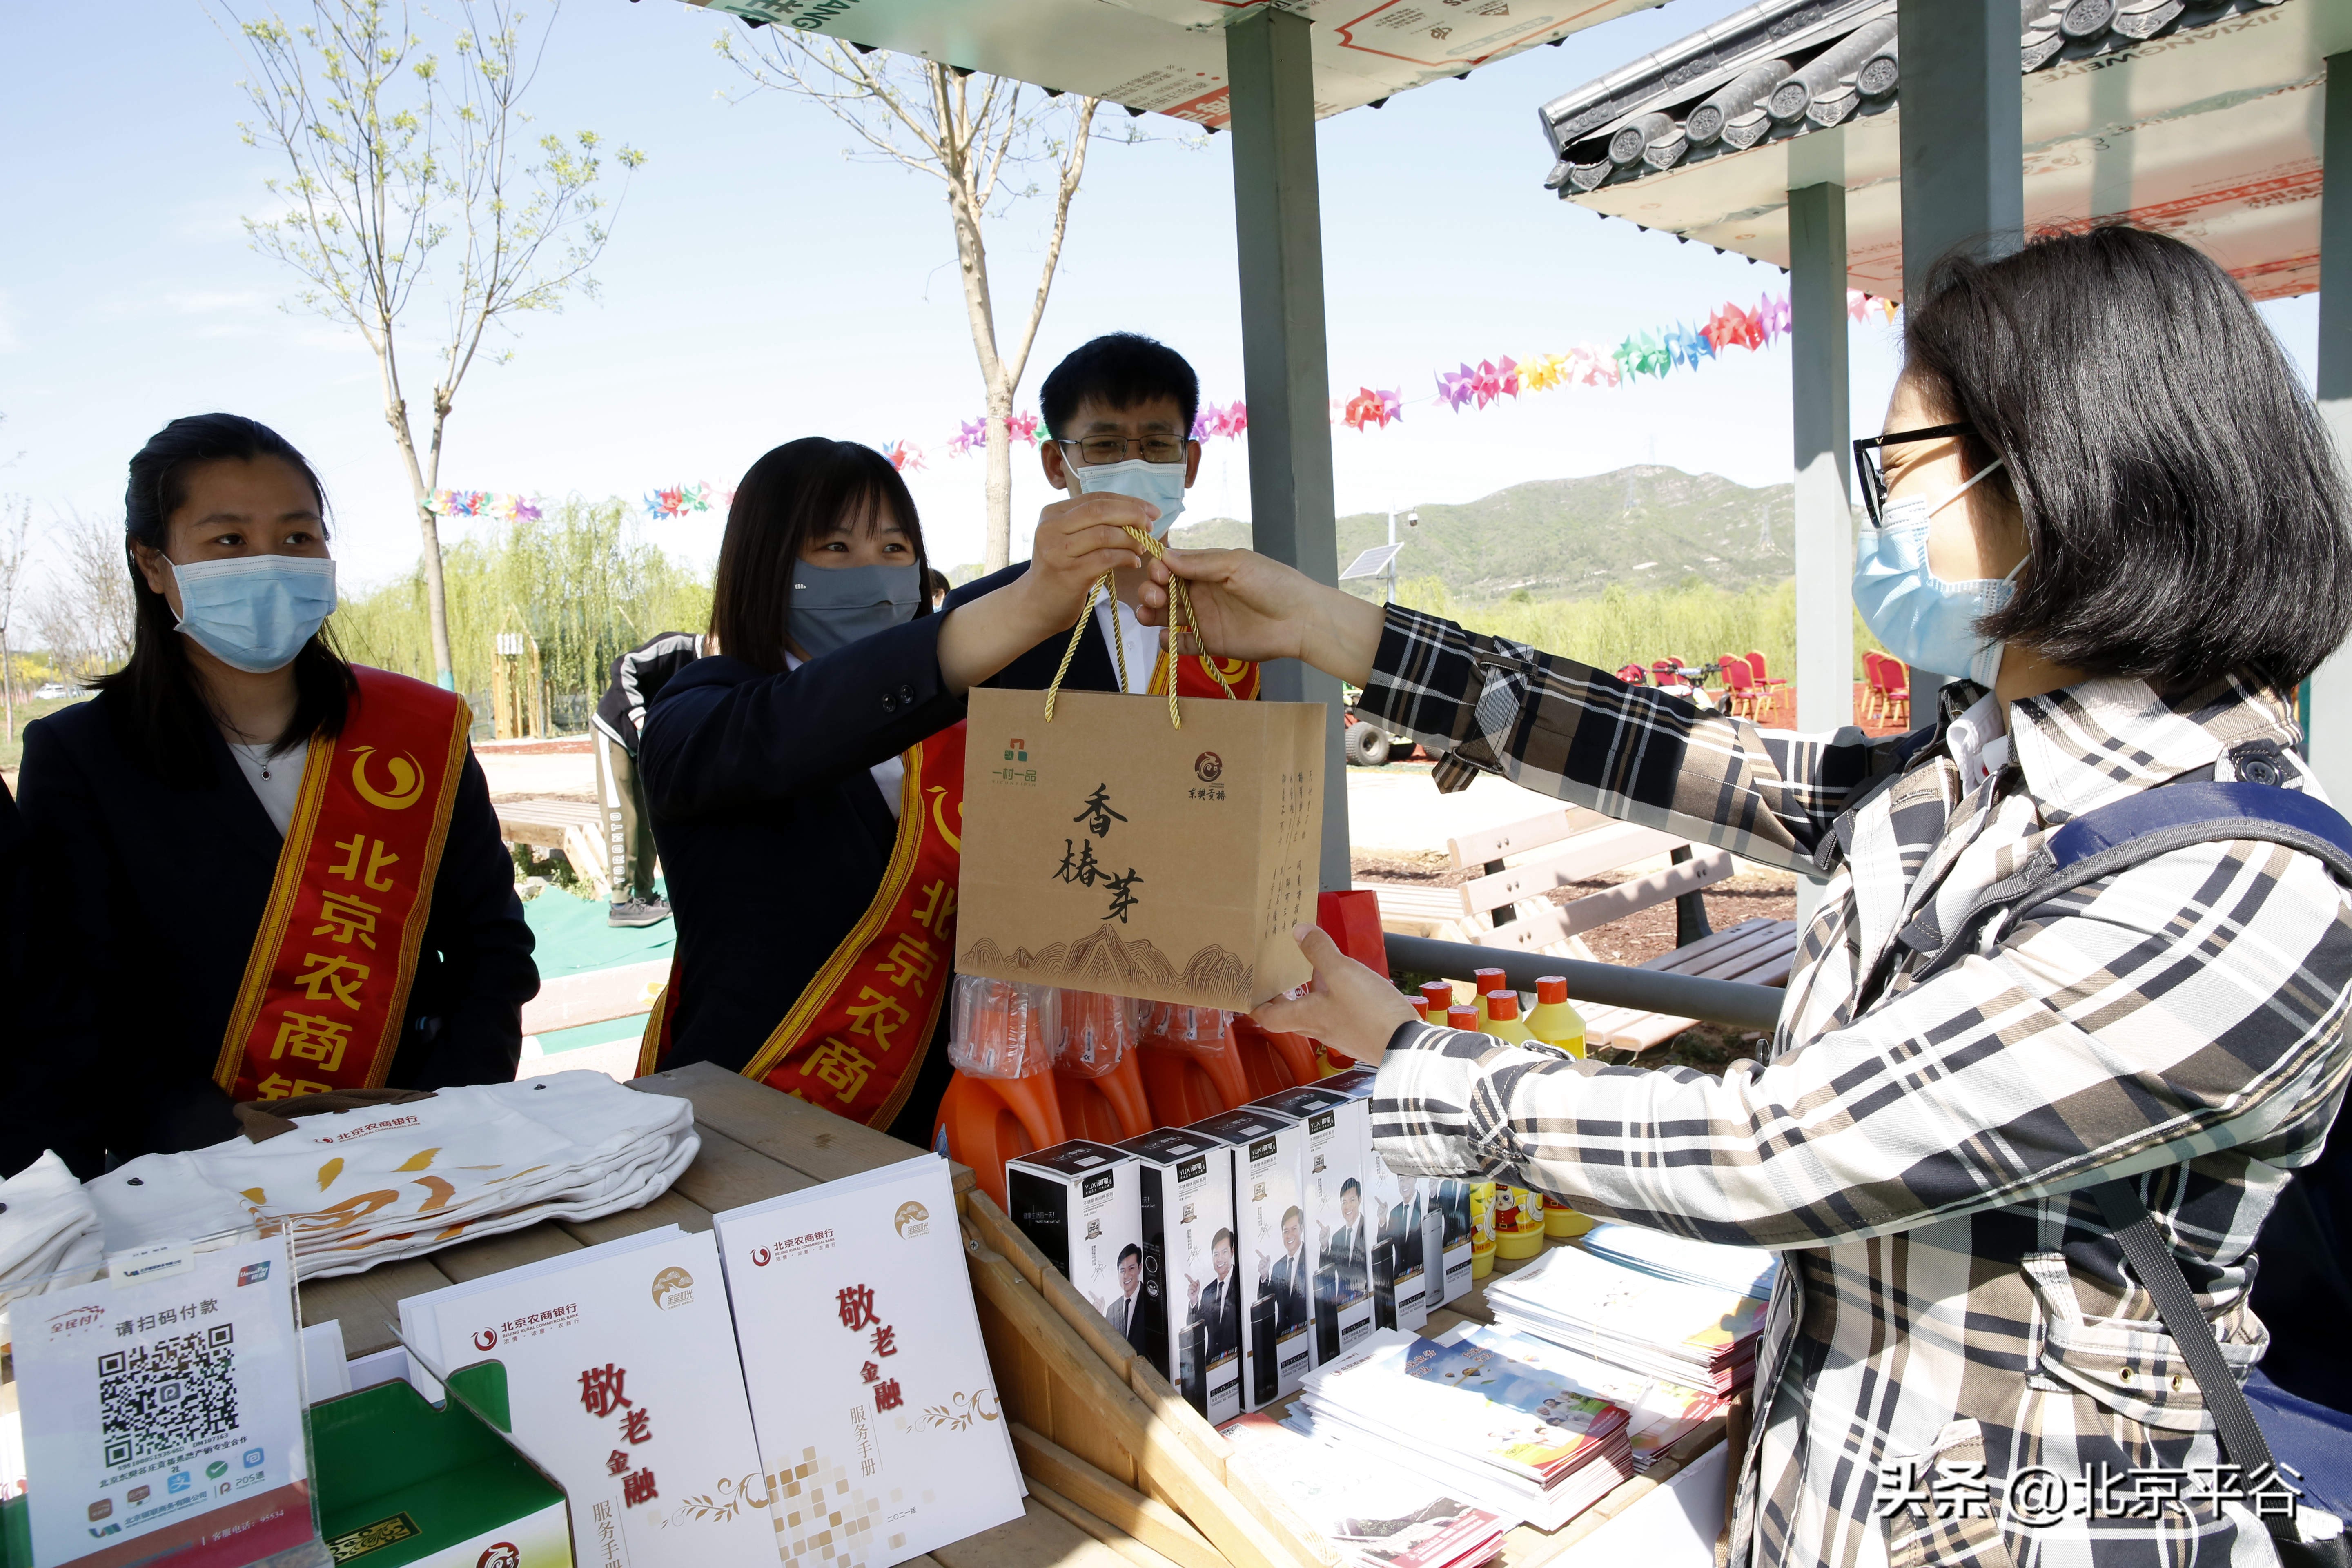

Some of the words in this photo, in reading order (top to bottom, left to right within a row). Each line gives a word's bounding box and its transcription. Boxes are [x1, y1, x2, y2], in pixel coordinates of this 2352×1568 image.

[992, 768, 1036, 782] 一村一品
[610, 812, 626, 885] TORONTO
[1052, 783, 1144, 924] 香椿芽
[337, 1115, 418, 1140] 北京农商银行
[774, 1228, 833, 1251] 北京农商银行
[801, 1241, 825, 1249] COMMERCIAL
[51, 1314, 98, 1334] 全民付
[115, 1298, 218, 1338] 请扫码付款
[501, 1303, 577, 1332] 北京农商银行
[536, 1317, 566, 1328] COMMERCIAL
[835, 1284, 904, 1414] 敬老金融
[578, 1363, 658, 1508] 敬老金融
[850, 1405, 876, 1478] 服务手册
[260, 1510, 284, 1523] 95534
